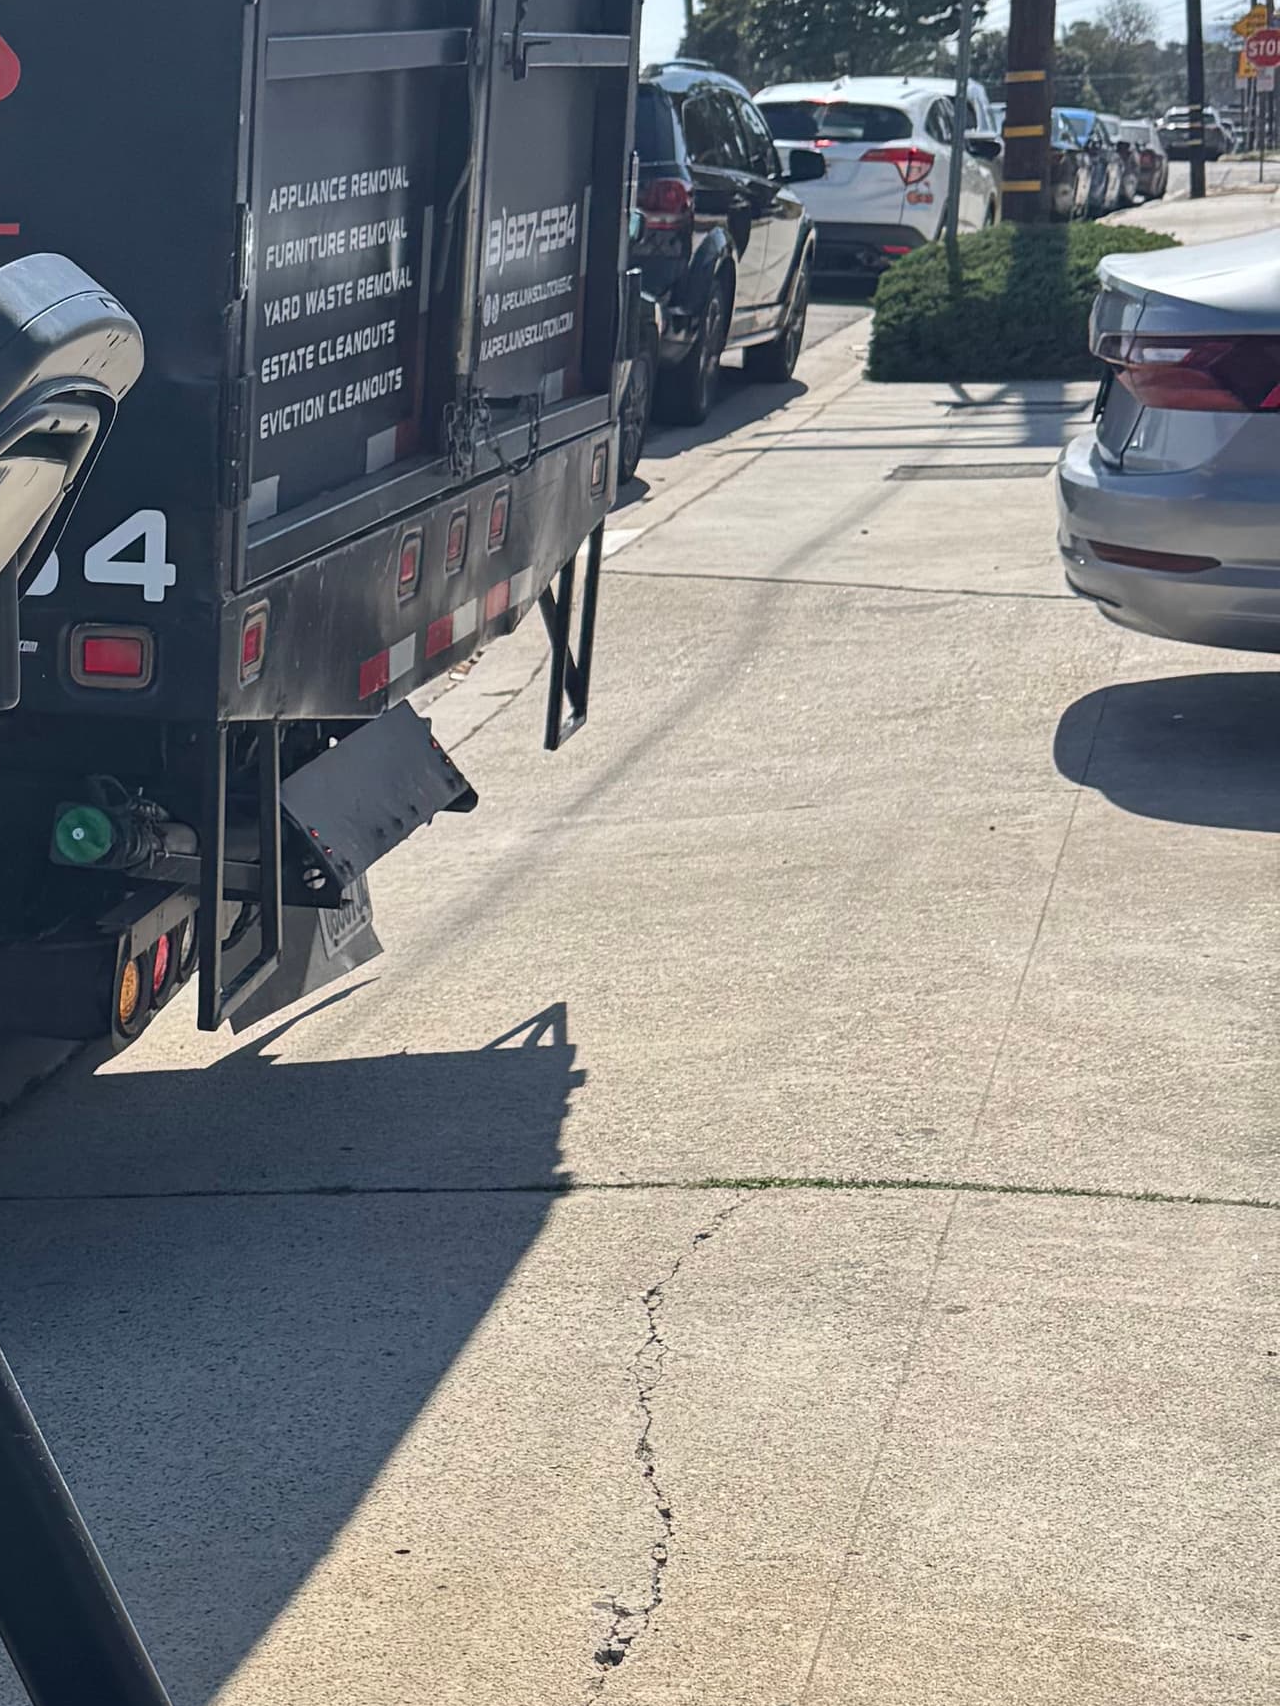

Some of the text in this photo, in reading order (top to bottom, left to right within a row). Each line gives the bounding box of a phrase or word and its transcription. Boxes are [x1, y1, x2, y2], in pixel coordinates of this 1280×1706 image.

[1247, 39, 1280, 58] STO
[268, 165, 410, 214] APPLIANCE REMOVAL
[266, 216, 407, 271] FURNITURE REMOVAL
[264, 265, 413, 327] YARD WASTE REMOVAL
[261, 320, 396, 384] ESTATE CLEANOUTS
[260, 366, 403, 440] EVICTION CLEANOUTS
